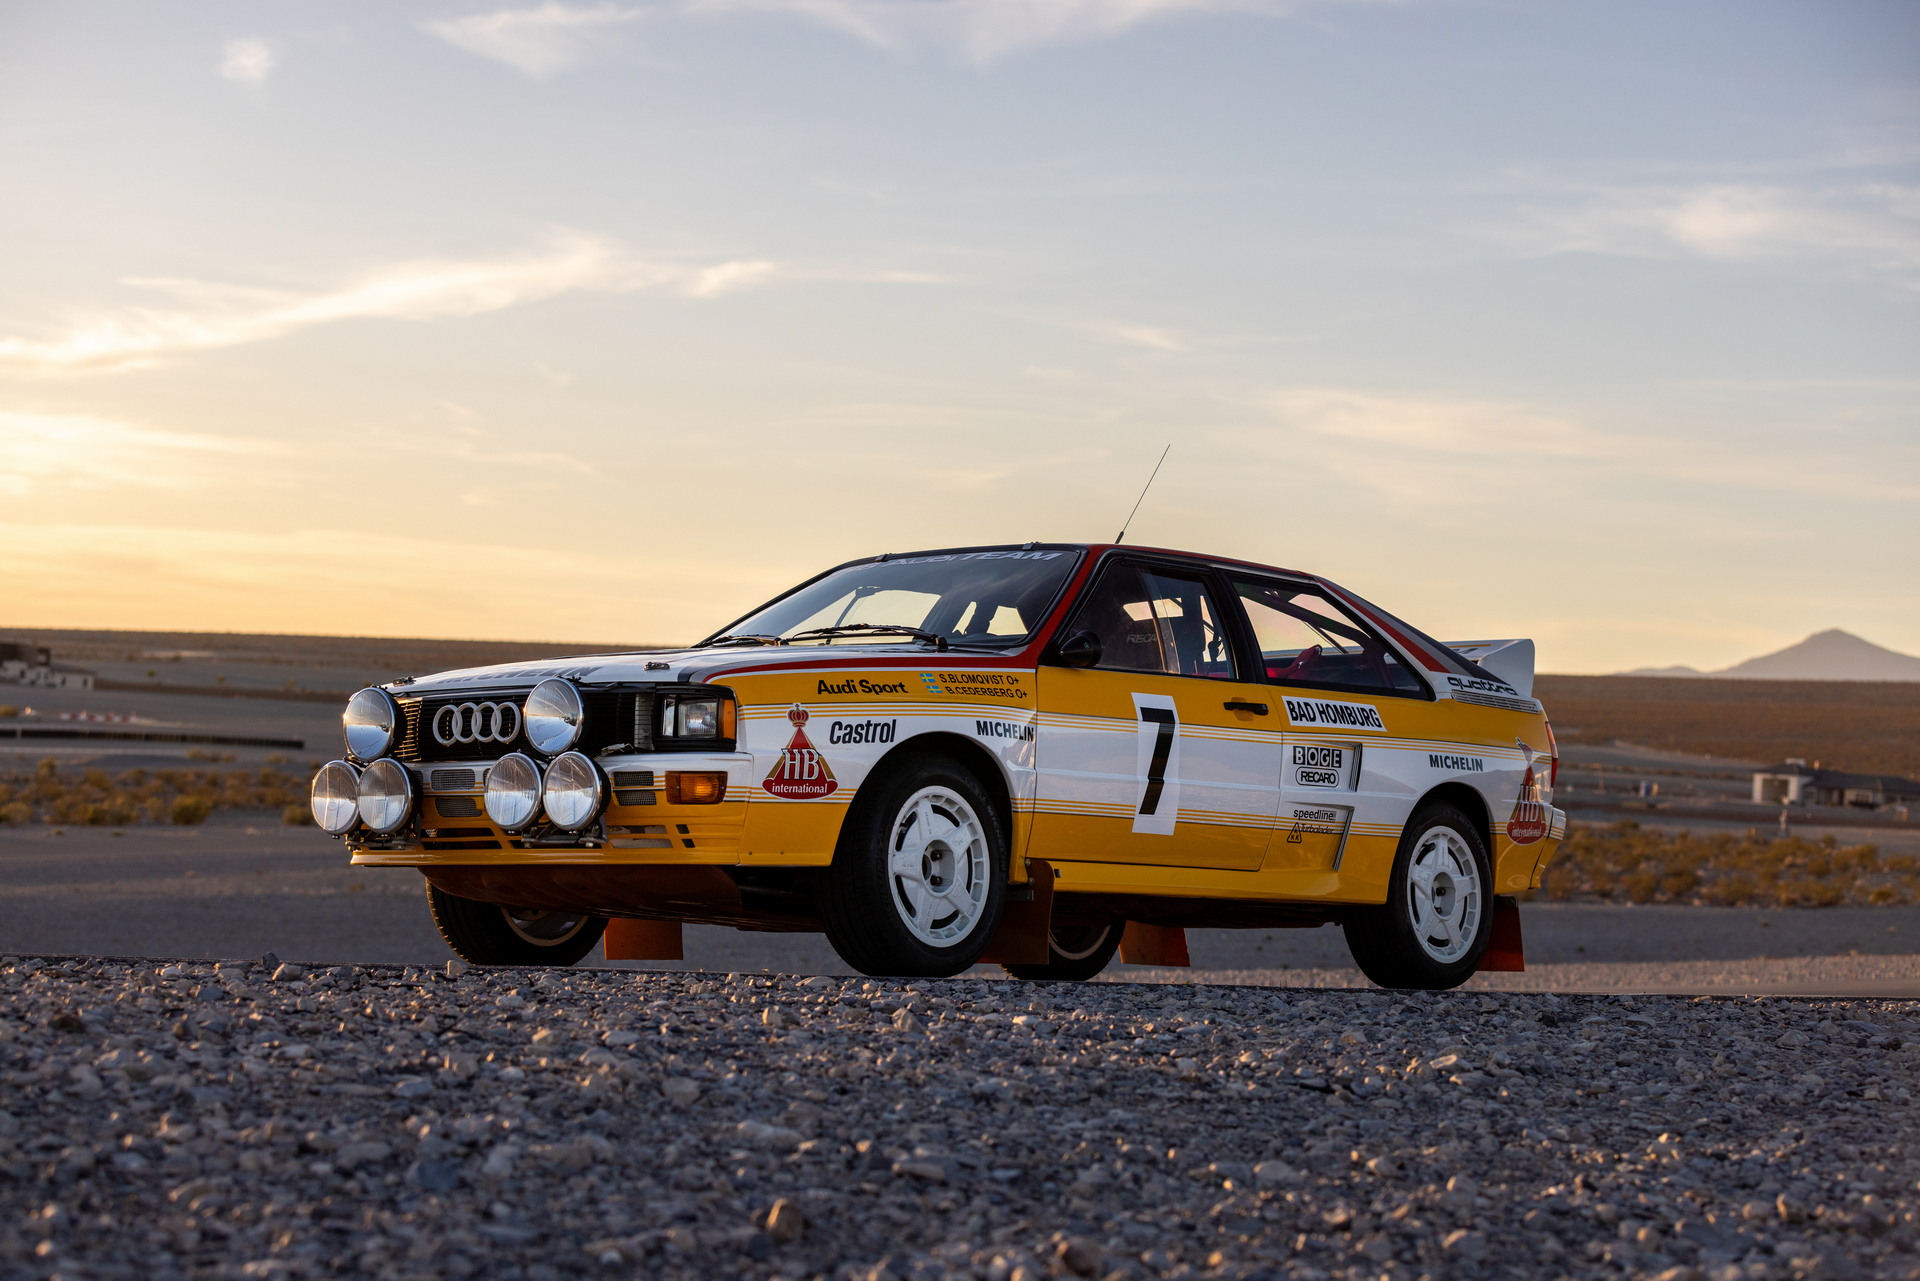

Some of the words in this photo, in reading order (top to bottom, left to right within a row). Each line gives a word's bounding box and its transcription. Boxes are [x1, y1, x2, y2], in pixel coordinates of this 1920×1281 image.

[960, 551, 1063, 561] TEAM
[817, 679, 858, 695] Audi
[861, 680, 908, 695] Sport
[939, 673, 1004, 686] S.BLOMQVIST
[1447, 676, 1519, 696] quattro
[946, 686, 1015, 699] B.CEDERBERG
[1286, 700, 1317, 722] BAD
[1315, 702, 1383, 728] HOMBURG
[829, 719, 897, 745] Castrol
[976, 720, 1035, 742] MICHELIN
[781, 748, 821, 780] HB
[1138, 707, 1176, 815] 7
[1294, 747, 1341, 768] BOGE
[1429, 754, 1484, 772] MICHELIN
[1300, 770, 1336, 784] RECARO
[771, 782, 828, 793] international
[1293, 809, 1335, 821] speedline
